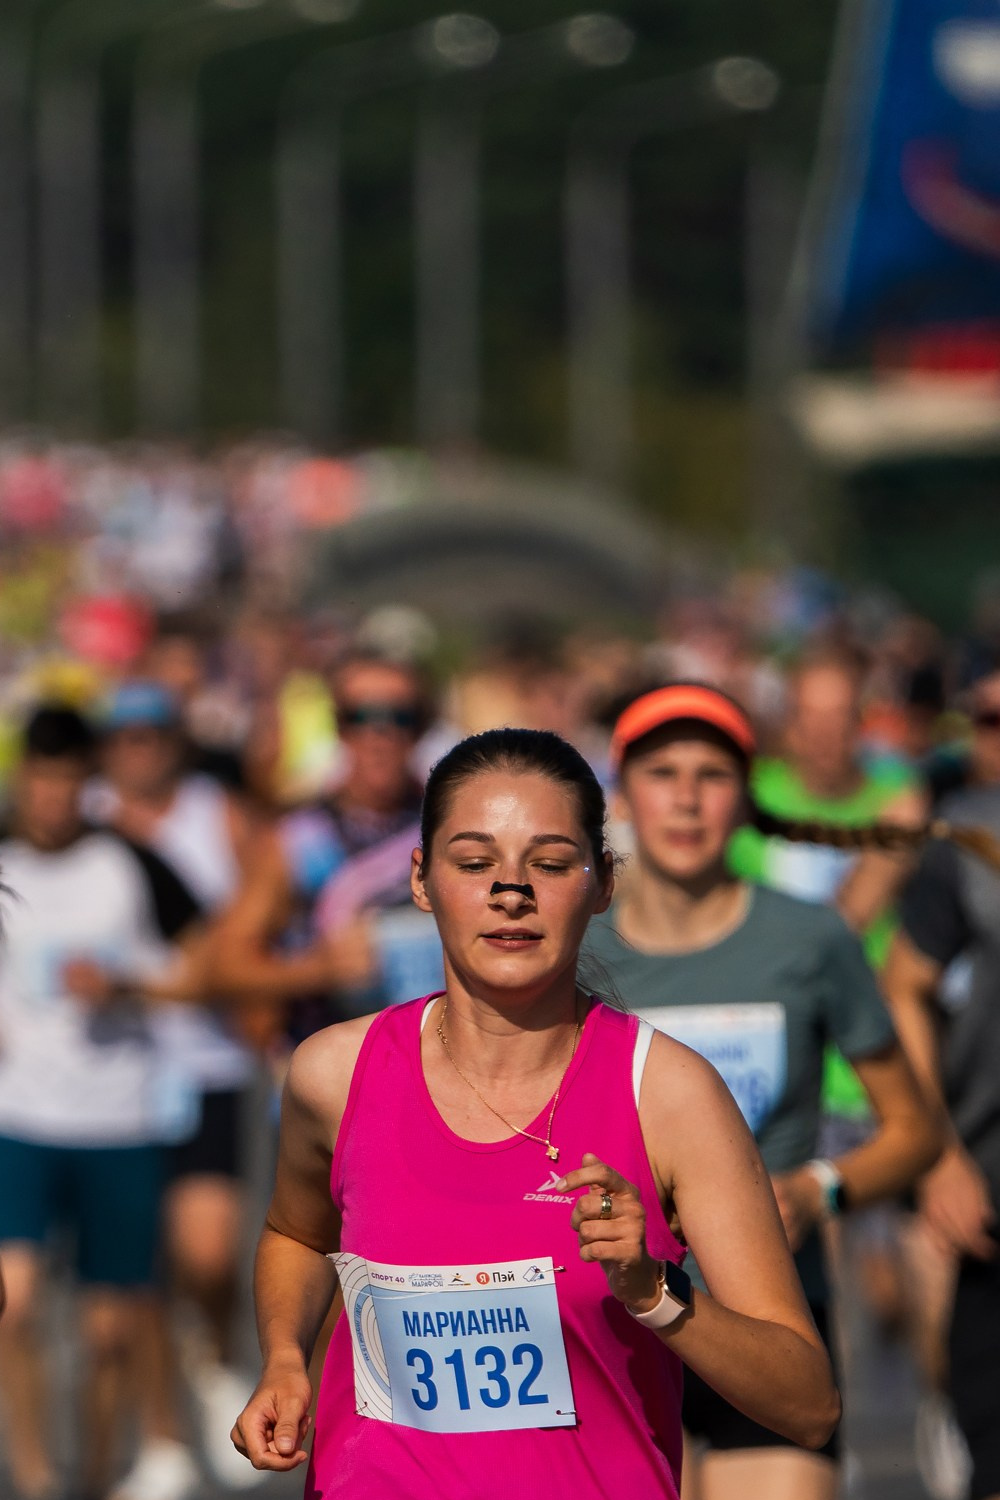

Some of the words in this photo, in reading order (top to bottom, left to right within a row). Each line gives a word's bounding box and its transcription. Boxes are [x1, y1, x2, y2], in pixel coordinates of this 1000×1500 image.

[523, 1193, 575, 1204] DEMIX
[371, 1272, 393, 1282] СПОРТ
[493, 1271, 515, 1283] Пэй
[403, 1307, 530, 1337] МАРИАННА
[406, 1343, 549, 1411] 3132
